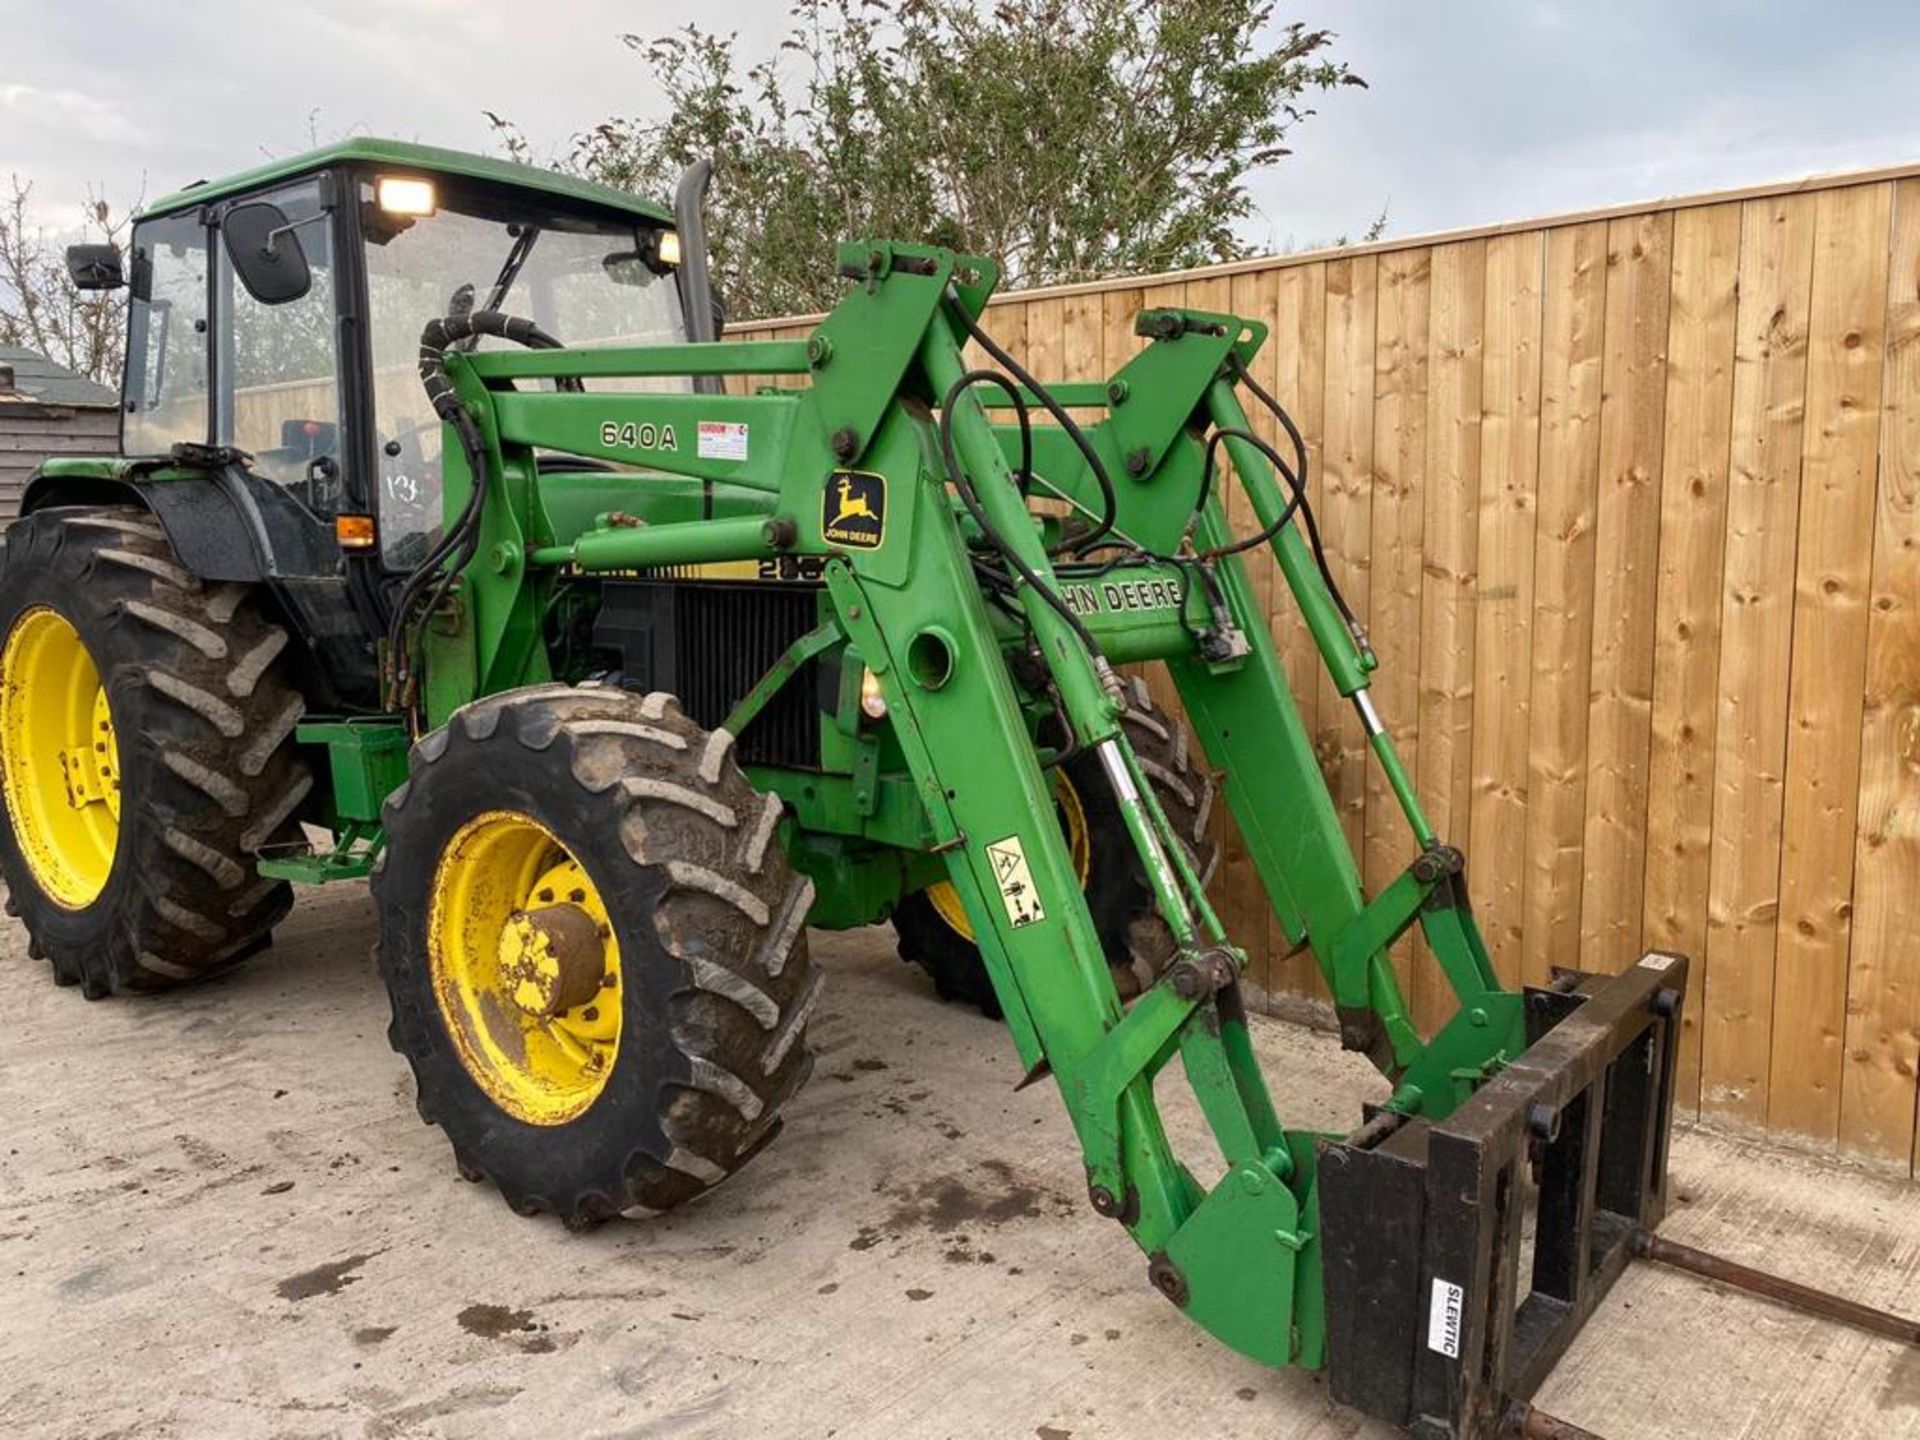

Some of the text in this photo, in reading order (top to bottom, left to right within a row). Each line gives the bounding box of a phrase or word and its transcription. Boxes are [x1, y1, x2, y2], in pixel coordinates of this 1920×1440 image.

[600, 421, 677, 451] 640A
[826, 528, 878, 544] JOHN DEERE
[1061, 578, 1183, 615] HN DEERE
[1443, 1286, 1460, 1355] SLEWTIC
